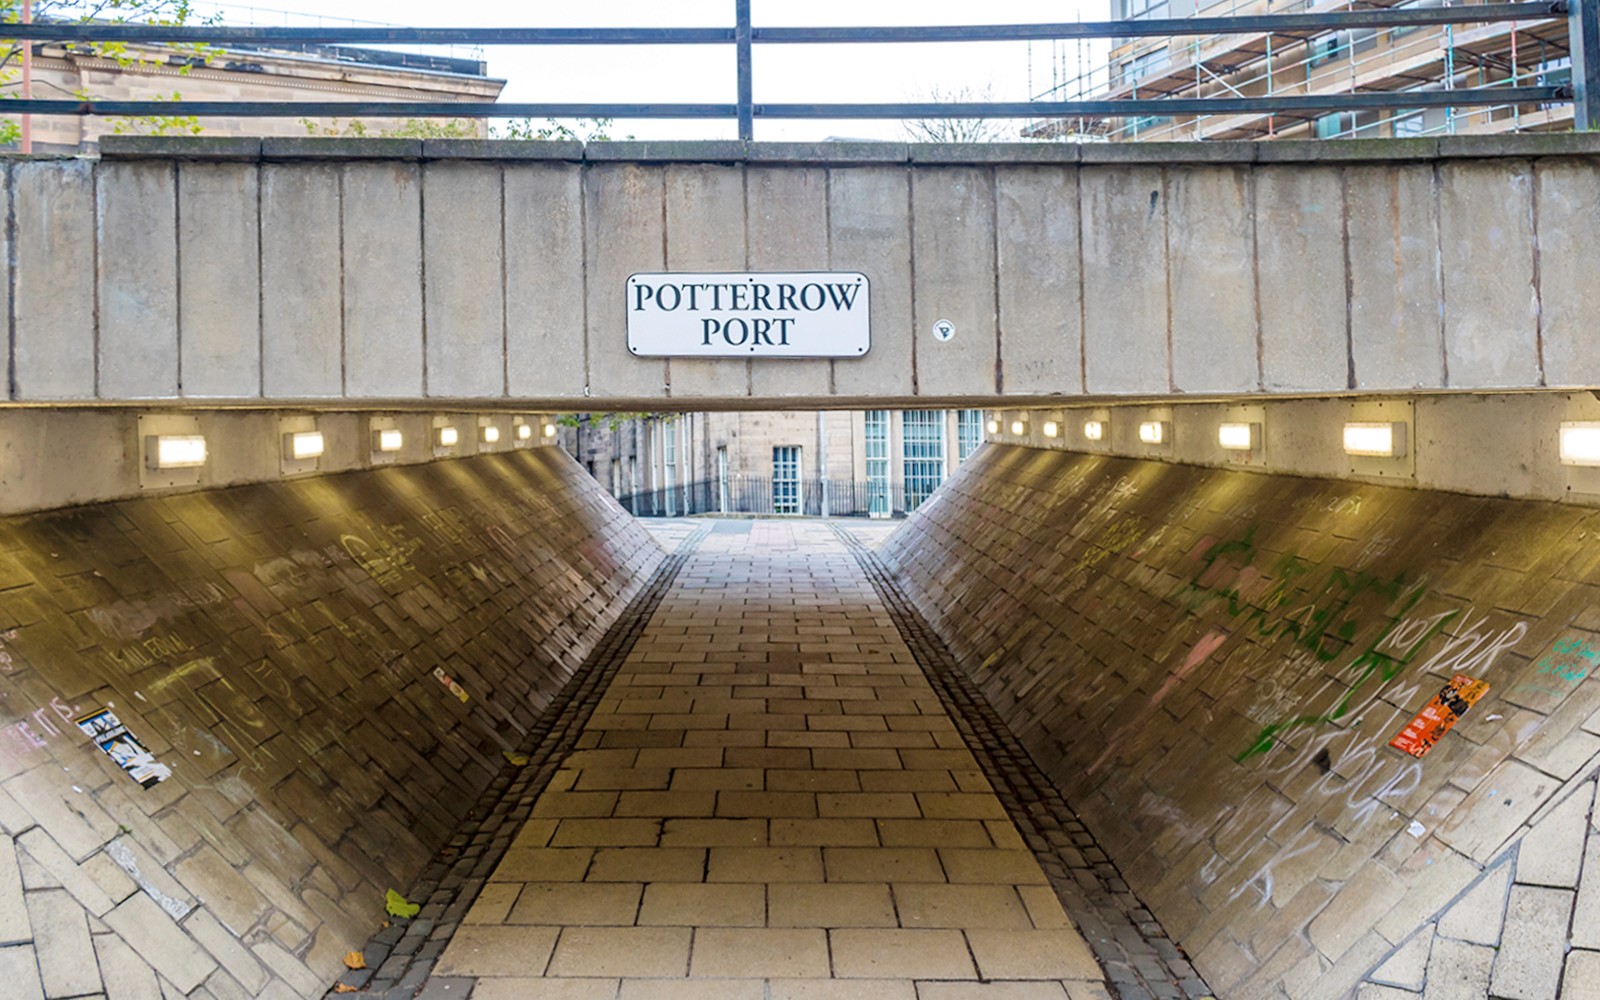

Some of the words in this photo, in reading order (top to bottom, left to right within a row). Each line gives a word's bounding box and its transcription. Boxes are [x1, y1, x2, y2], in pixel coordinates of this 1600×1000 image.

[634, 282, 860, 312] POTTERROW
[700, 318, 795, 346] PORT
[1374, 608, 1461, 657] NOT
[1416, 606, 1528, 678] YOUR
